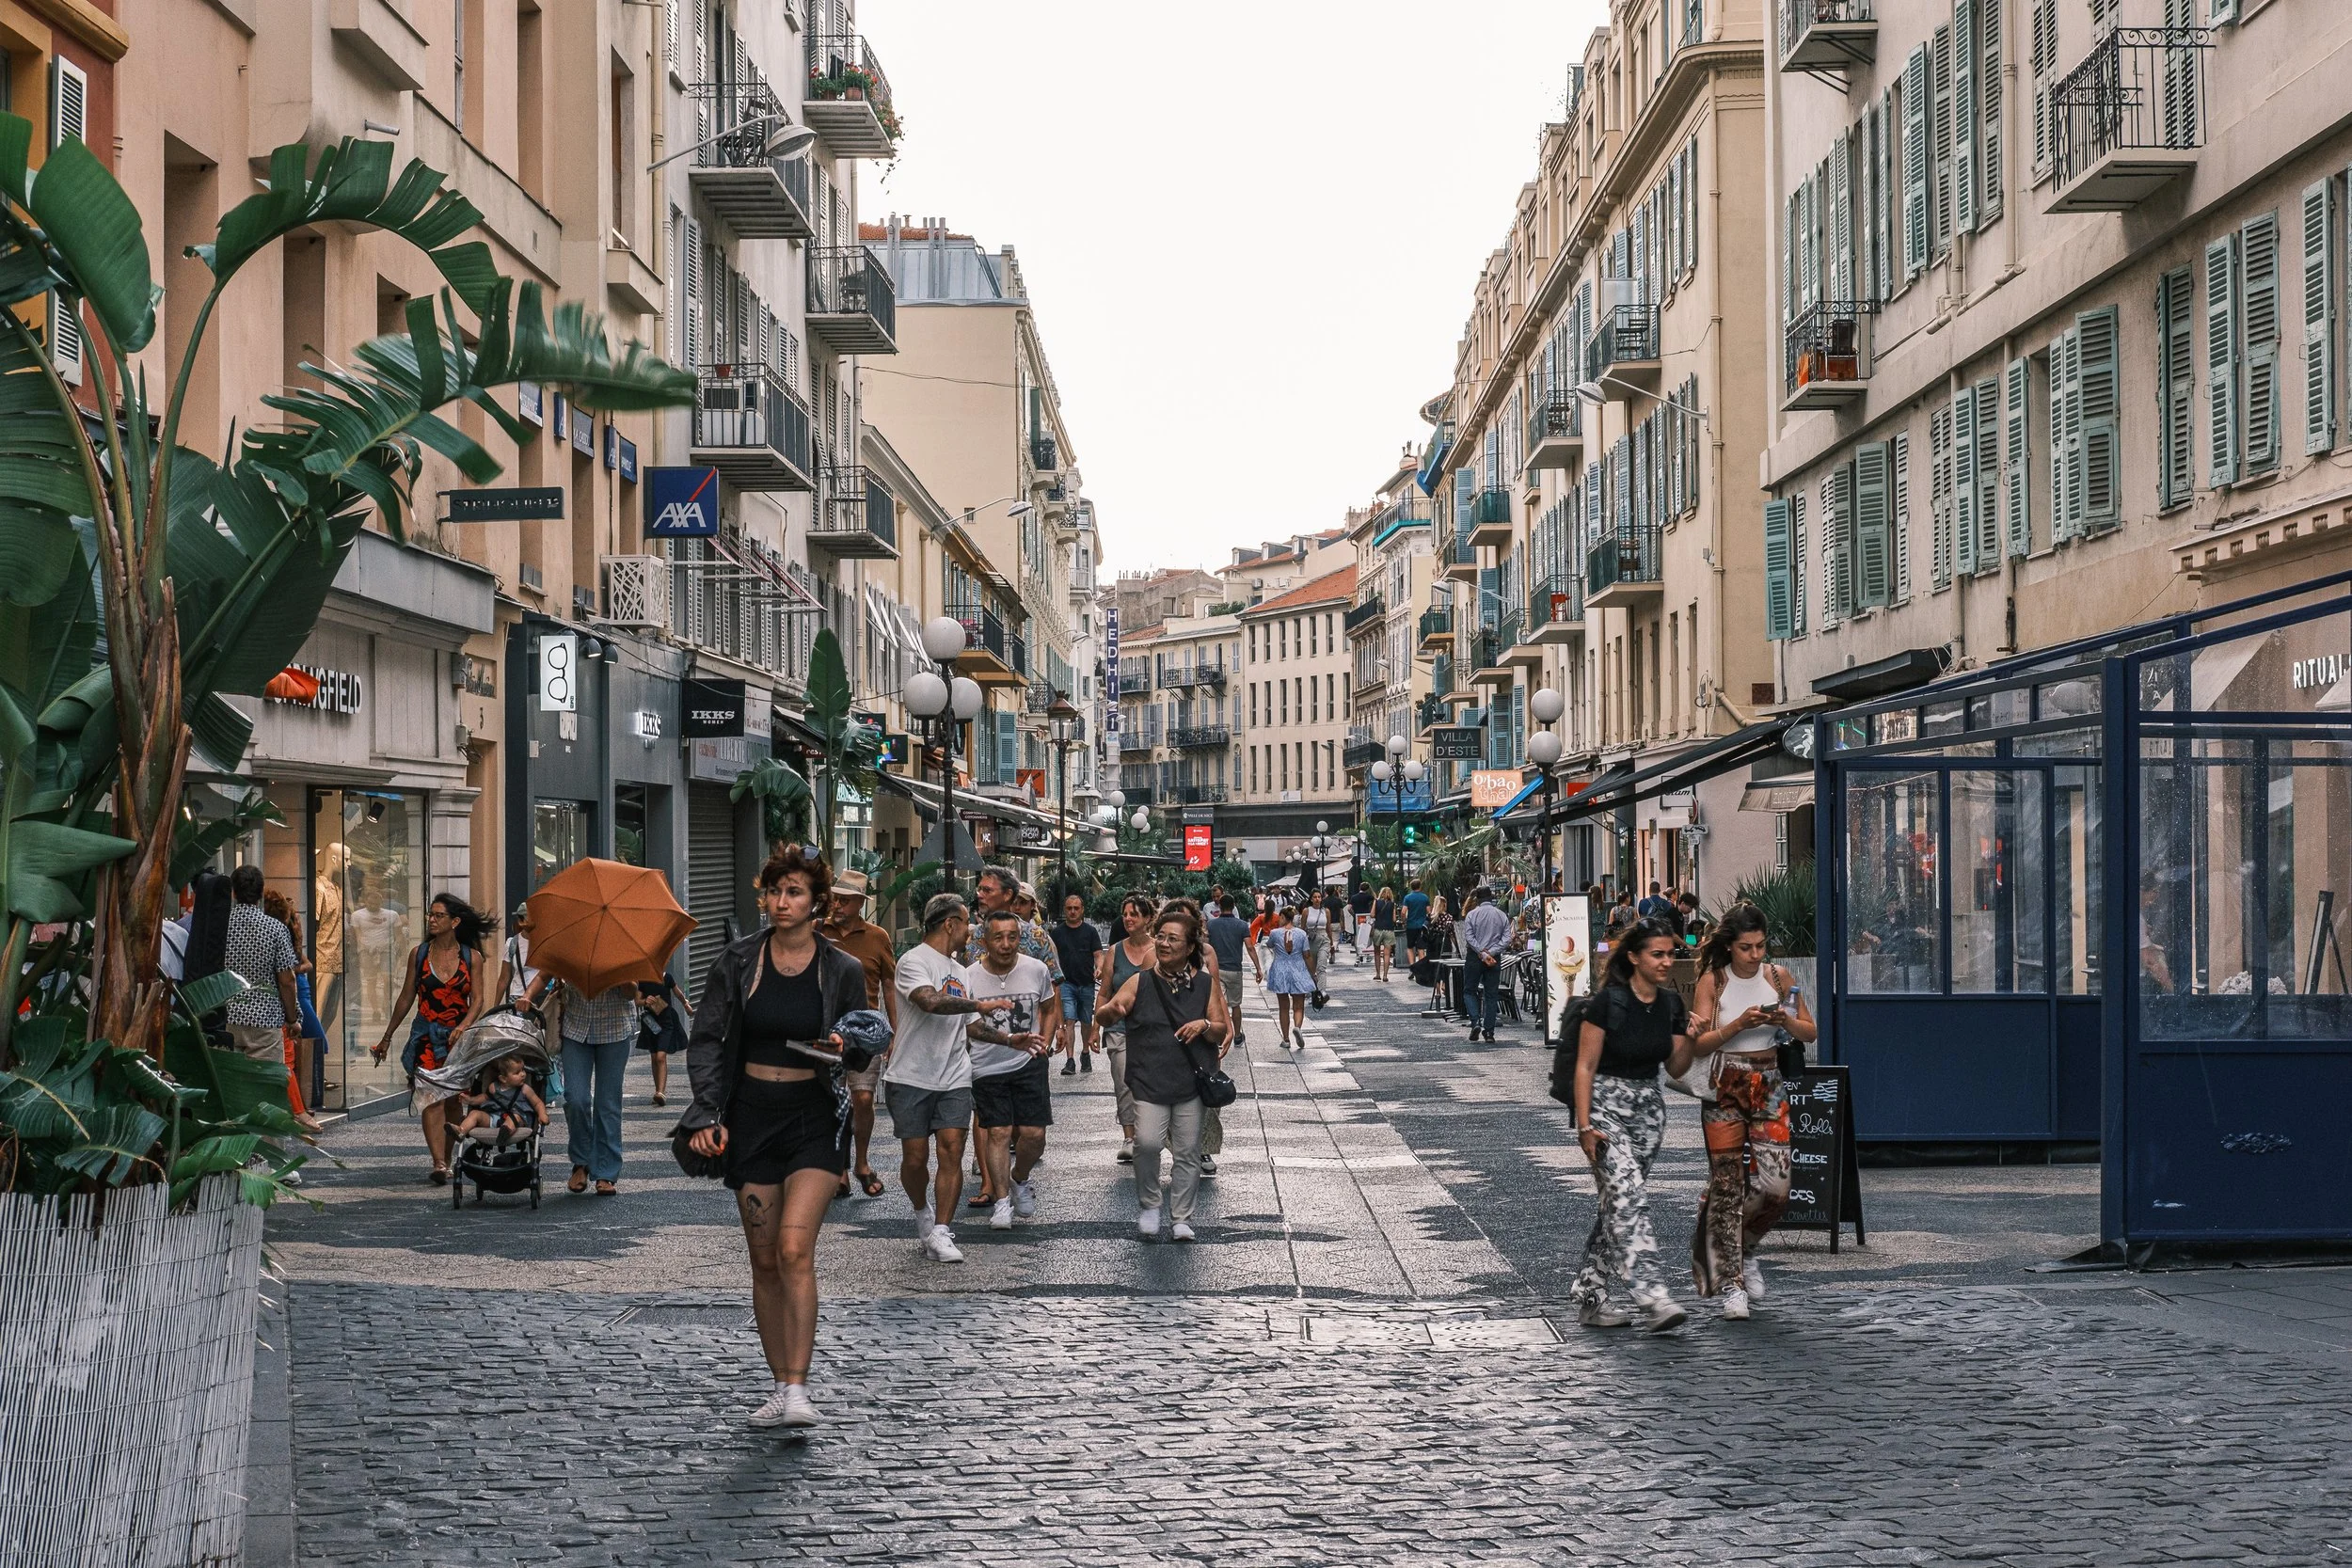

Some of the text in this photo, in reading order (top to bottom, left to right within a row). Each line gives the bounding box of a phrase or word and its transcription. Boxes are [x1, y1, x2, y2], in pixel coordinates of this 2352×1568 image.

[652, 502, 707, 529] AXA
[2293, 654, 2351, 689] RITUAL
[274, 662, 362, 715] GFIELD
[691, 710, 736, 720] IKKS
[642, 712, 661, 738] IKKS
[1441, 732, 1473, 742] VILLA
[1436, 746, 1479, 756] D'ESTE
[1473, 774, 1517, 791] o'bao
[1789, 1094, 1812, 1105] RT
[1799, 1113, 1834, 1135] Rolls
[1789, 1189, 1816, 1204] DES
